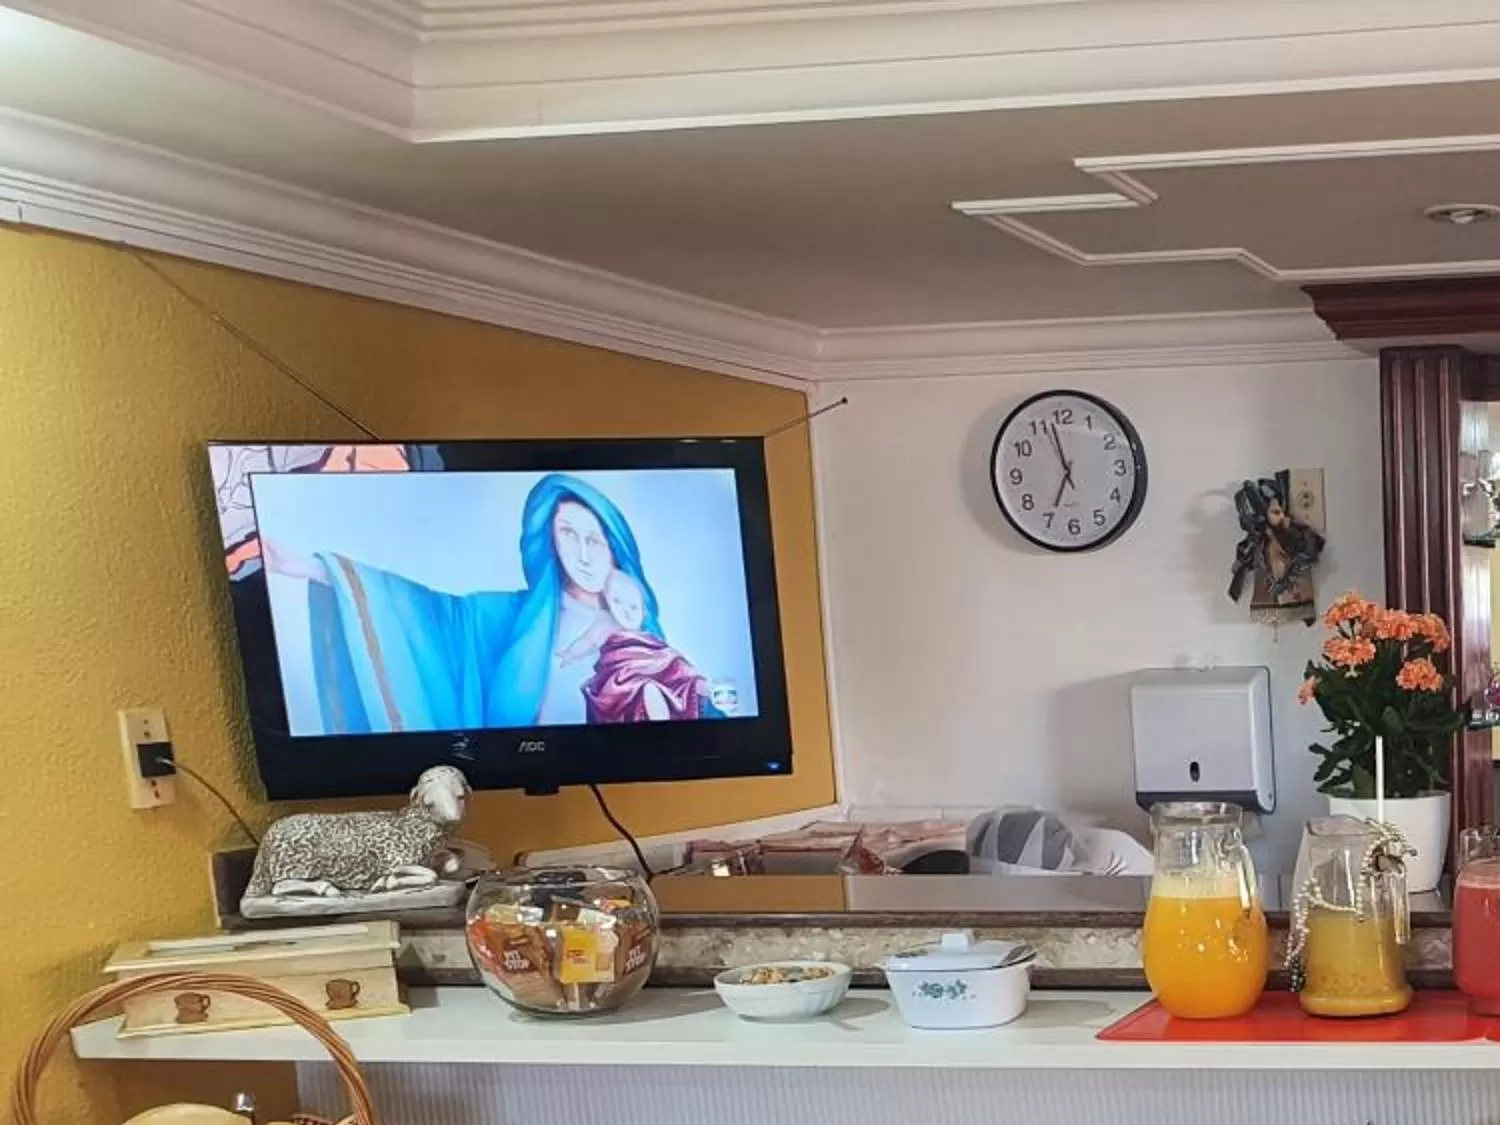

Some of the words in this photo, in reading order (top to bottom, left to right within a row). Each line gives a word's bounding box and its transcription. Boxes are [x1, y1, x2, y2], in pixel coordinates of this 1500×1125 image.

[1052, 408, 1074, 425] 12
[1084, 415, 1093, 431] 1
[1030, 419, 1048, 436] 11
[1014, 439, 1033, 457] 10
[1103, 433, 1116, 450] 2
[1113, 459, 1127, 476] 3
[1009, 468, 1023, 485] 9
[1021, 493, 1035, 511] 8
[1109, 486, 1121, 503] 4
[1042, 512, 1056, 529] 7
[1093, 509, 1106, 526] 5
[1067, 518, 1081, 535] 6
